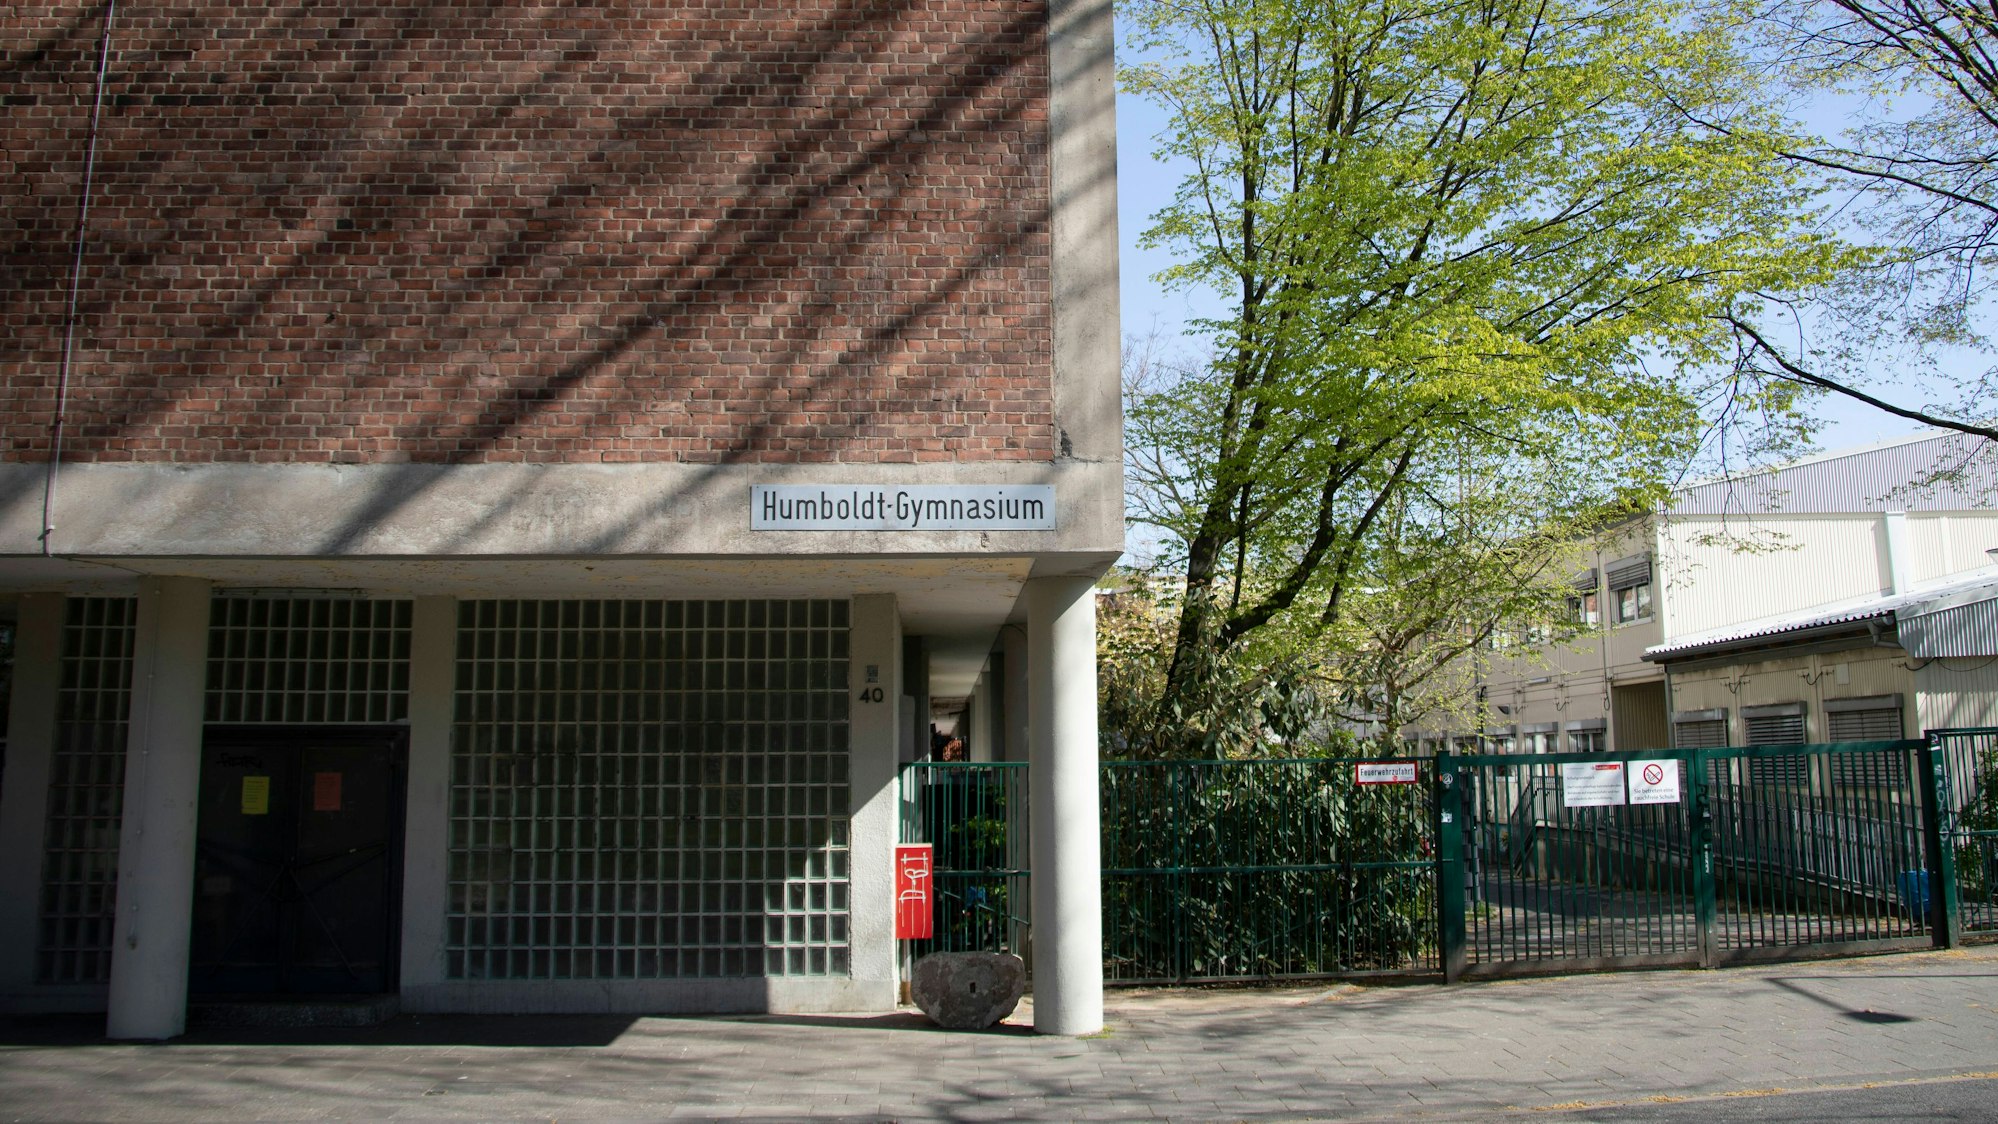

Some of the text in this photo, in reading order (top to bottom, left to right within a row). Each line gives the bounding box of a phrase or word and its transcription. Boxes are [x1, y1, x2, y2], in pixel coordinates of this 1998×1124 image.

[763, 491, 1044, 528] Humboldt-Gymnasium
[859, 687, 884, 704] 40
[1360, 768, 1414, 776] Feuerwehrzufahrt
